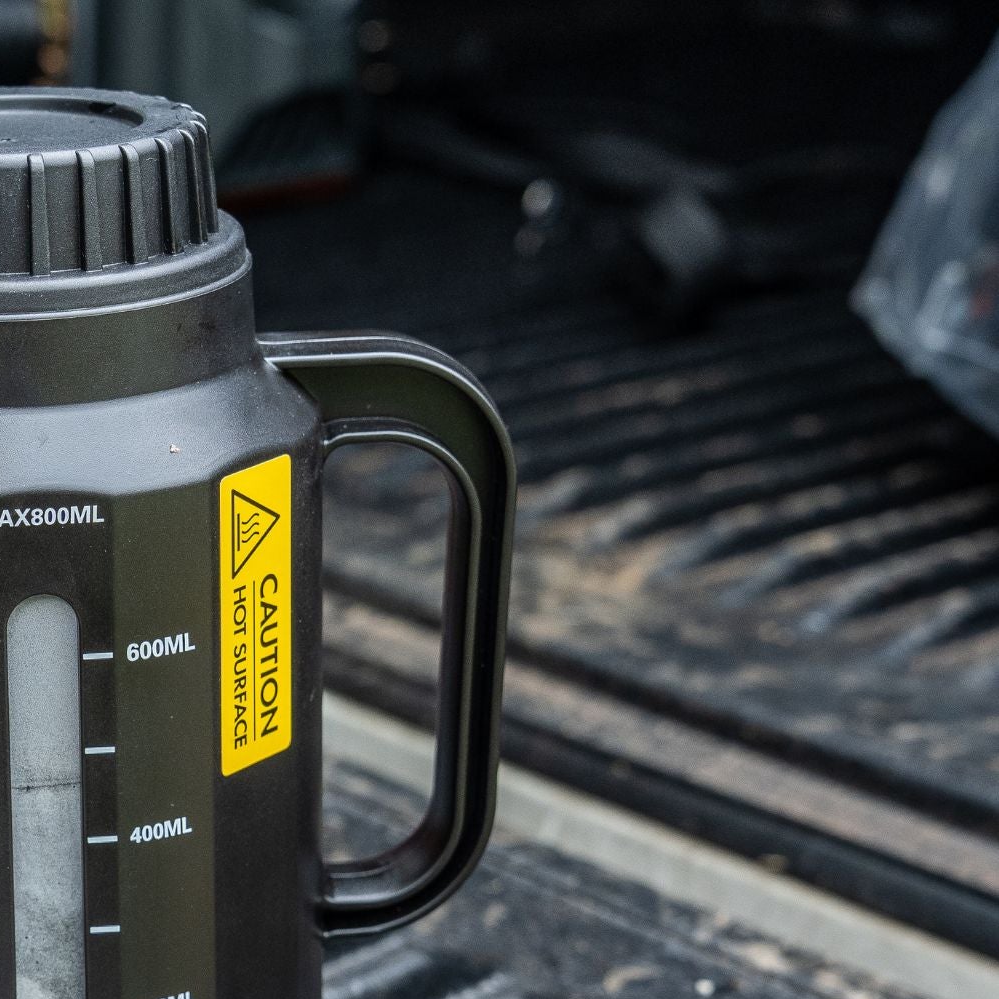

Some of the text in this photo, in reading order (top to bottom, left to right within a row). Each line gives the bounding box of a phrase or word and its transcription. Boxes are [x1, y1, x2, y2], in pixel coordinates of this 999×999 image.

[126, 632, 196, 662] 600ML
[233, 585, 248, 750] HOT SURFACE
[260, 573, 278, 738] CAUTION
[129, 816, 193, 844] 400ML
